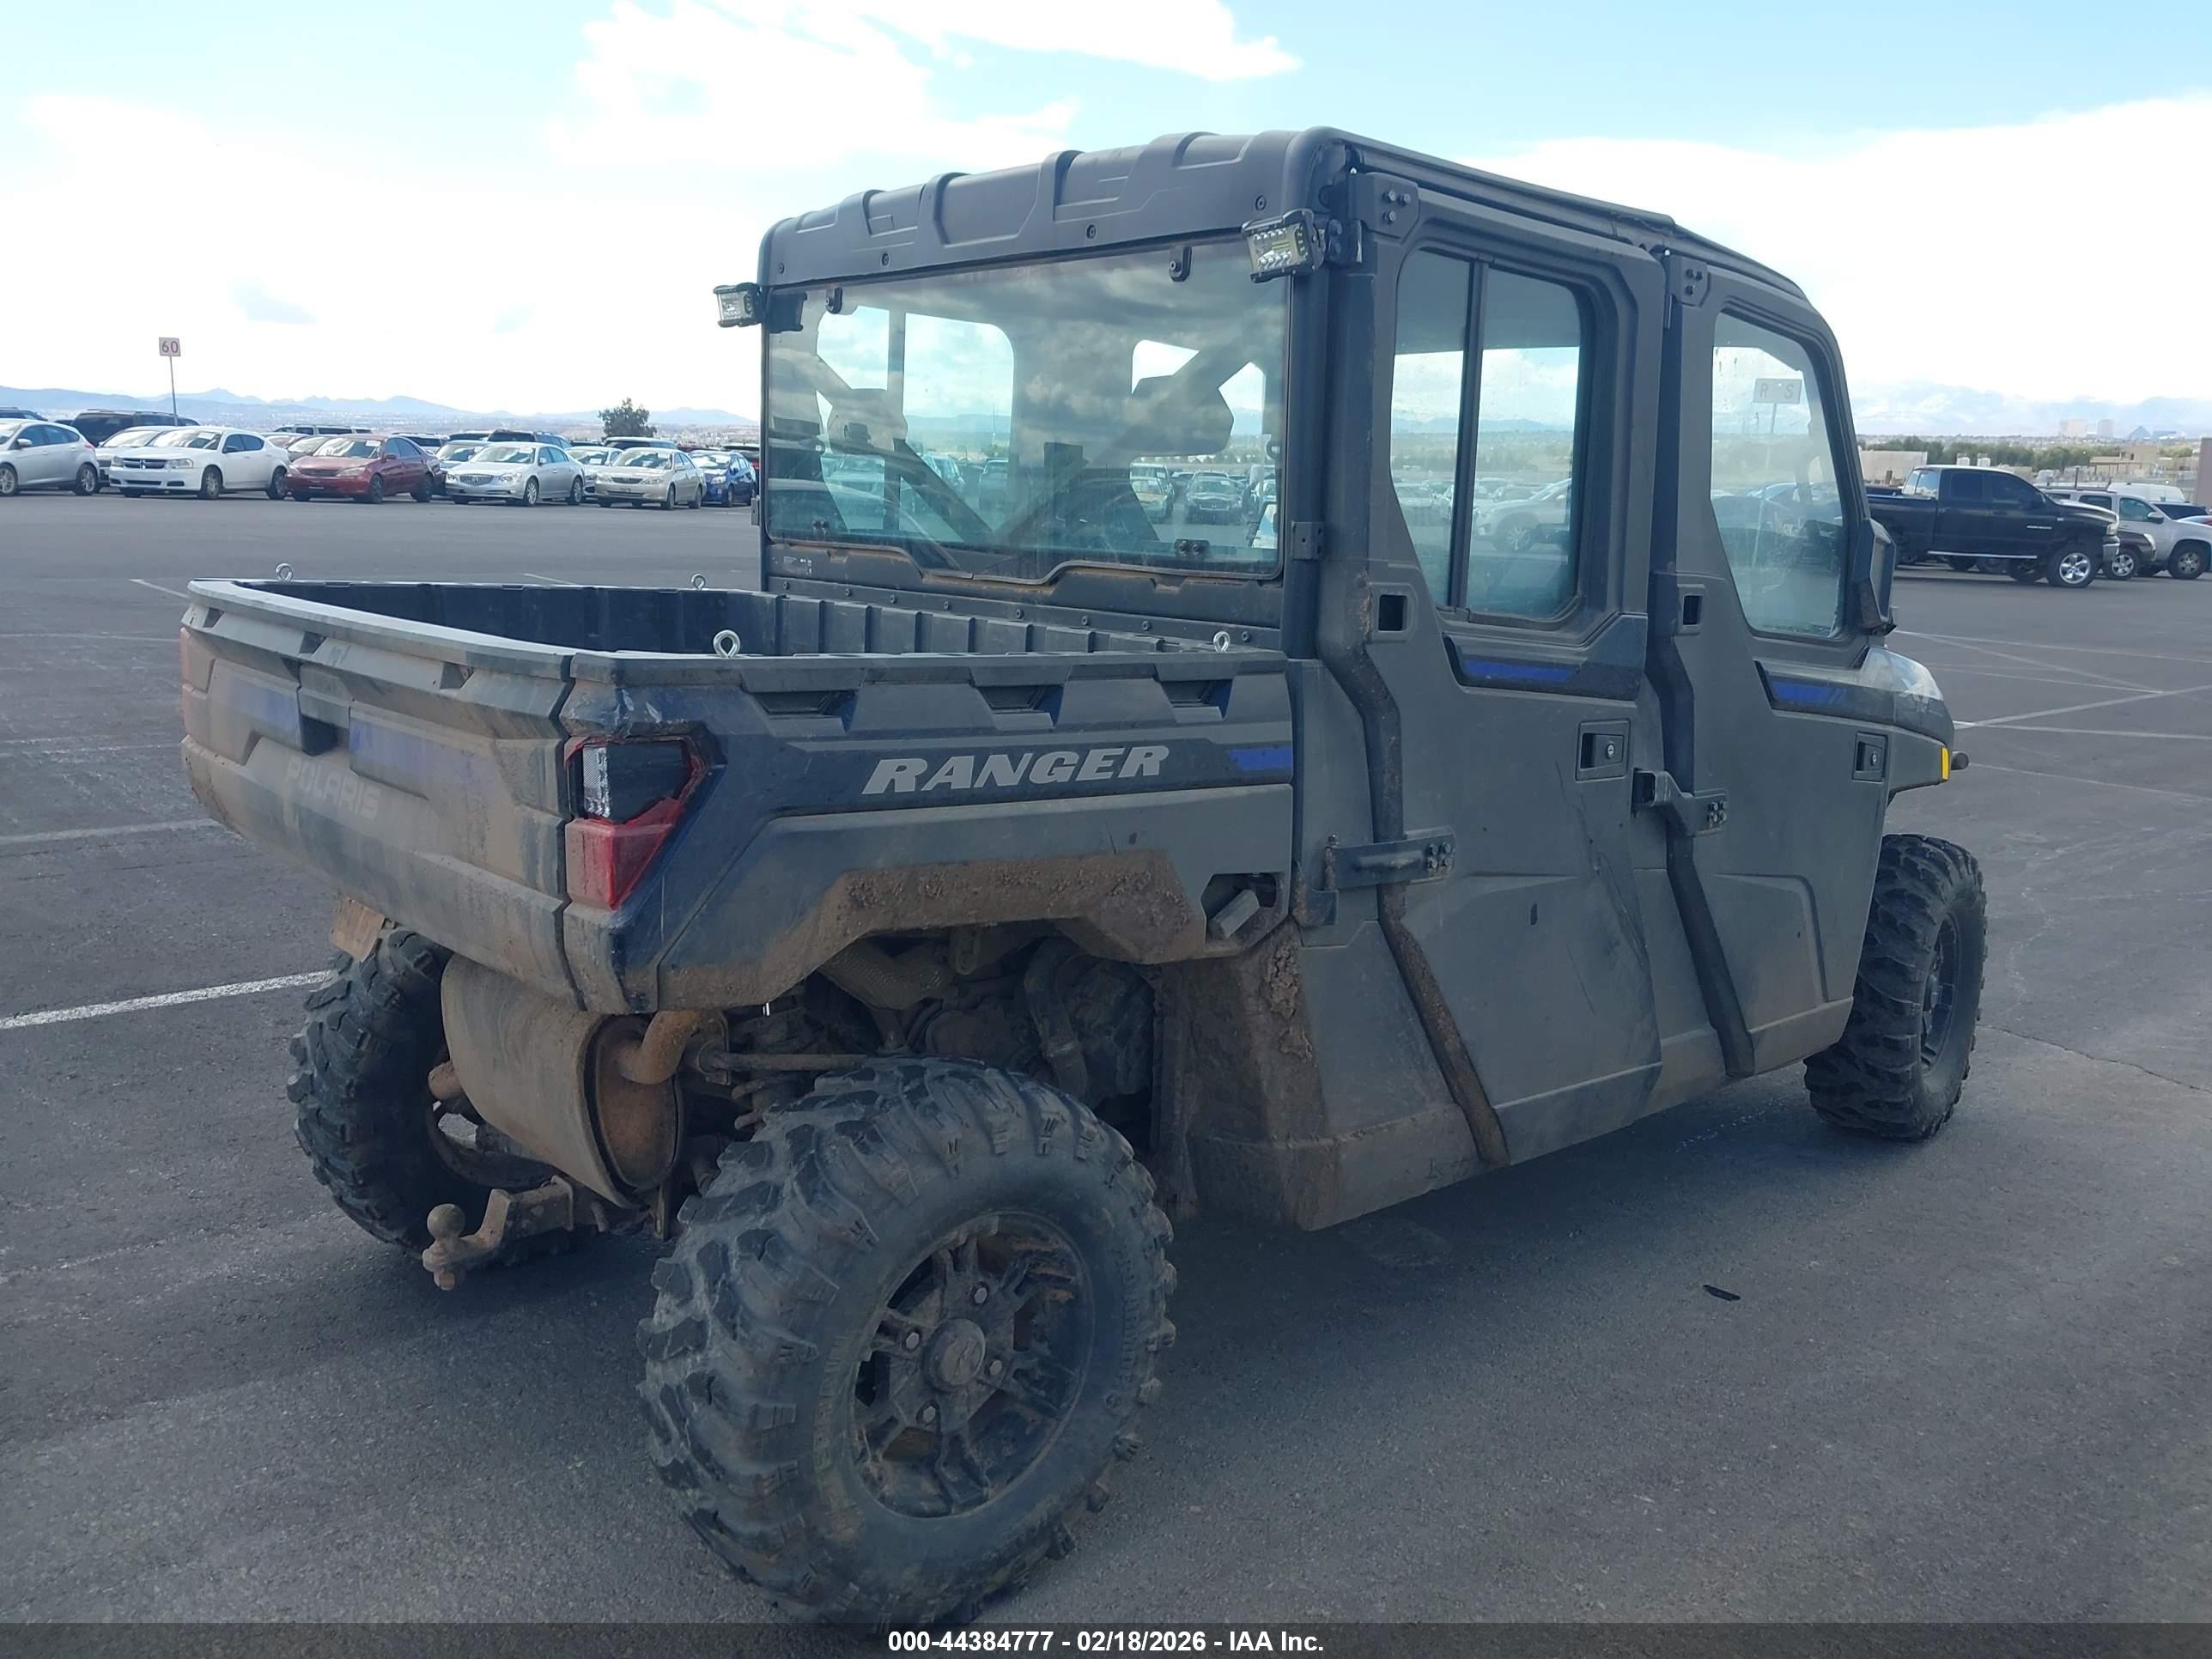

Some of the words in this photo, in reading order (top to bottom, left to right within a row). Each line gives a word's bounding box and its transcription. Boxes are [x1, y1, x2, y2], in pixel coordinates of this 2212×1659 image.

[161, 340, 179, 354] 60
[285, 756, 382, 820] POLARIS
[861, 745, 1170, 795] RANGER
